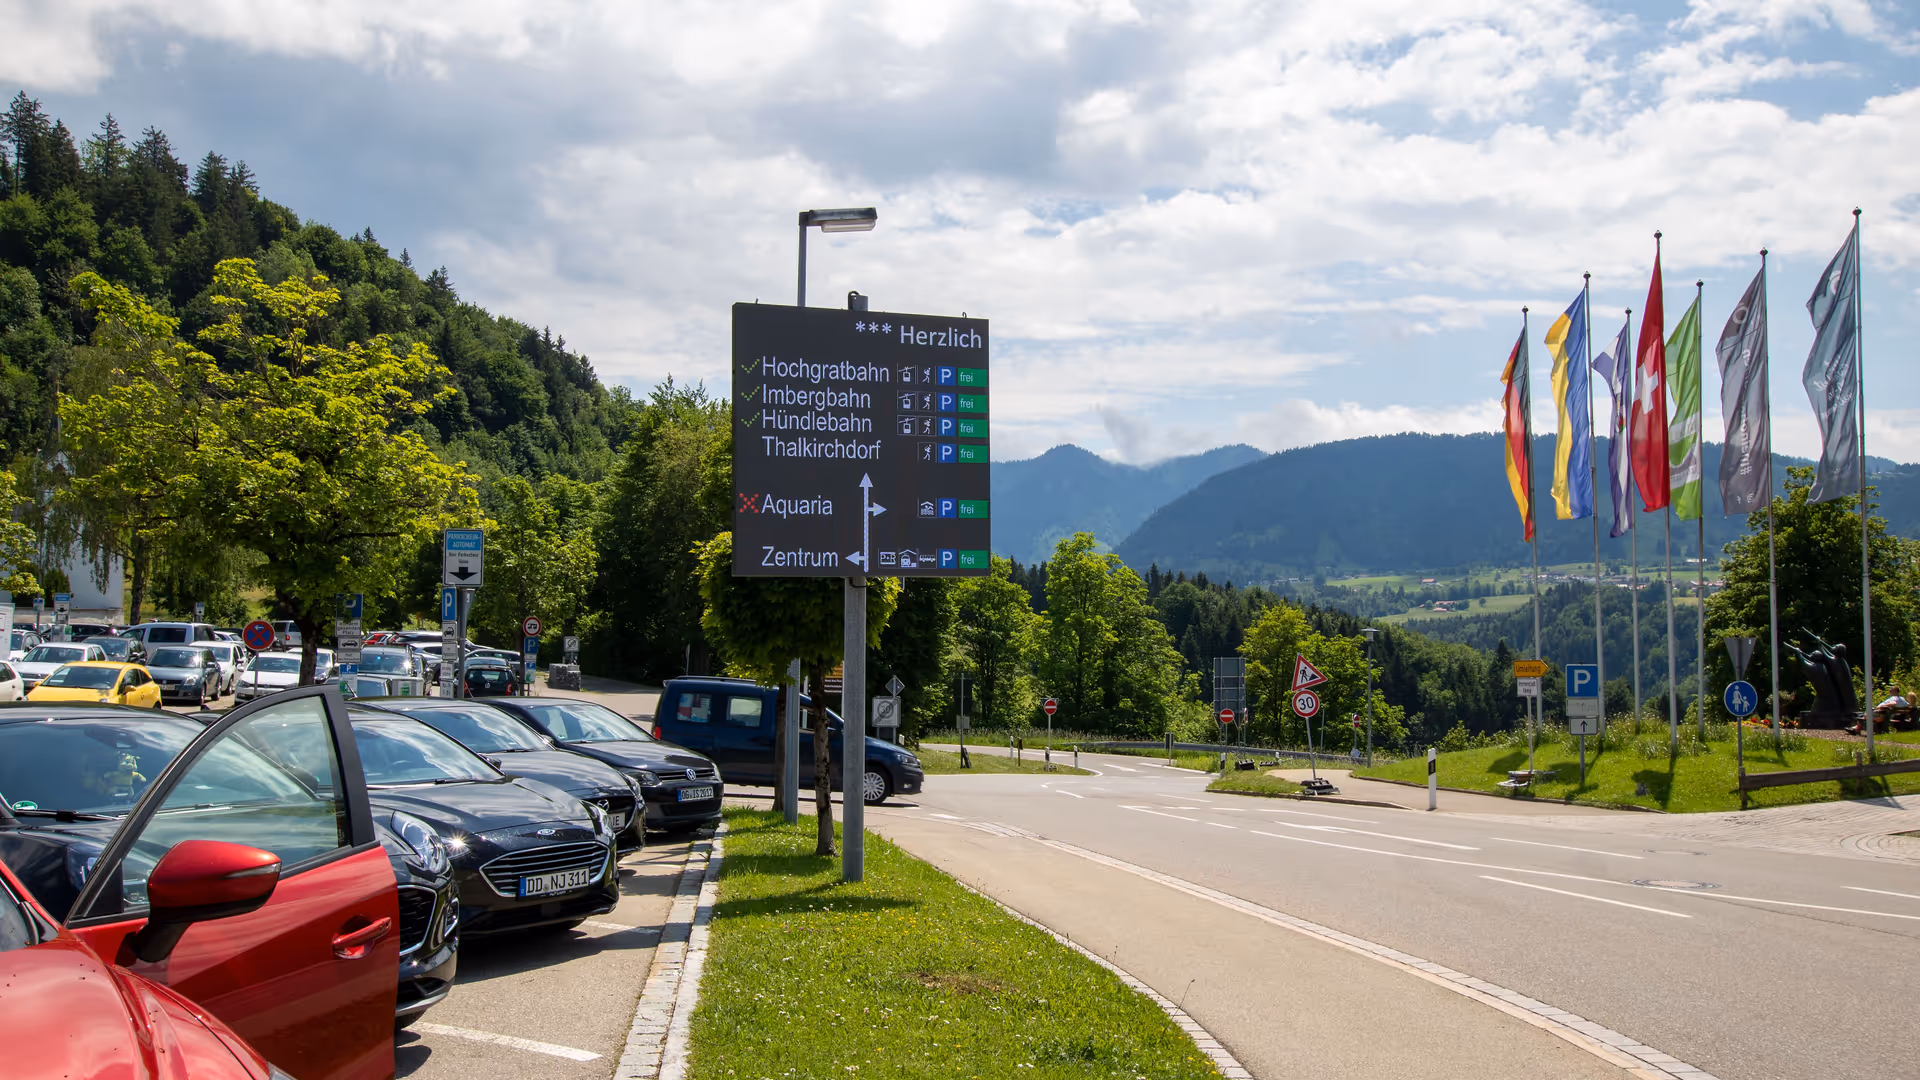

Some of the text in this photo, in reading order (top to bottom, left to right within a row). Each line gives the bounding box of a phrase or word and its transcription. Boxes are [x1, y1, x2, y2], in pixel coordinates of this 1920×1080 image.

[900, 325, 982, 349] Herzlich
[762, 356, 974, 384] Hochgratbahn P frei
[763, 383, 974, 411] Imbergbahn P frei
[762, 408, 974, 435] Hündlebahn P frei
[762, 436, 974, 461] Thalkirchdorf P frei
[761, 493, 974, 520] Aquaria P frei
[761, 546, 839, 568] Zentrum
[942, 551, 953, 567] P
[960, 554, 975, 566] frei
[444, 592, 452, 617] P
[527, 639, 536, 652] P
[1574, 669, 1591, 694] P
[880, 705, 891, 714] 30
[1298, 696, 1315, 711] 30
[527, 870, 587, 893] DD NJ 311
